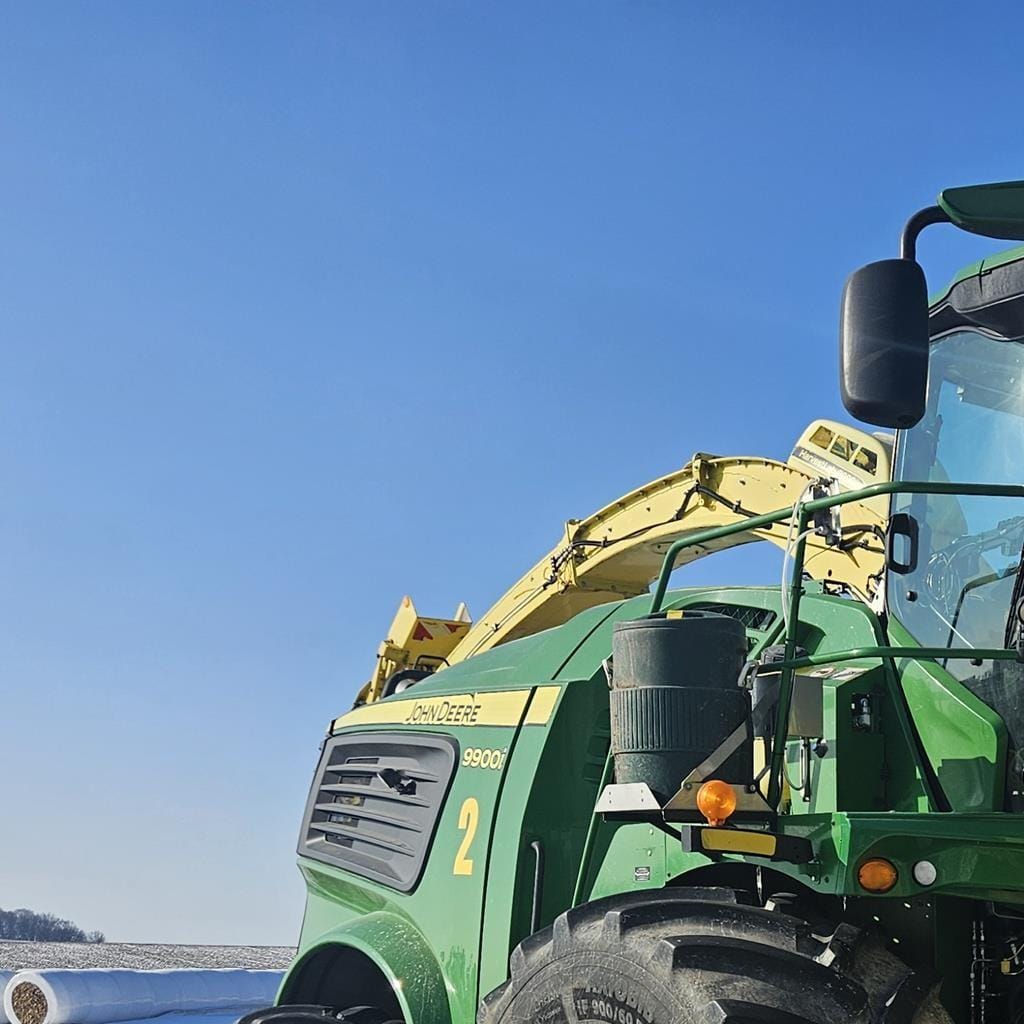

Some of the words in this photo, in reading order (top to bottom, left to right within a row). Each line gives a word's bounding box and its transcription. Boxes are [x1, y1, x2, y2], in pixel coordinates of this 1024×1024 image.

[405, 701, 439, 722] JOHN
[437, 701, 482, 722] DEERE
[462, 747, 507, 770] 9900i
[453, 797, 479, 875] 2
